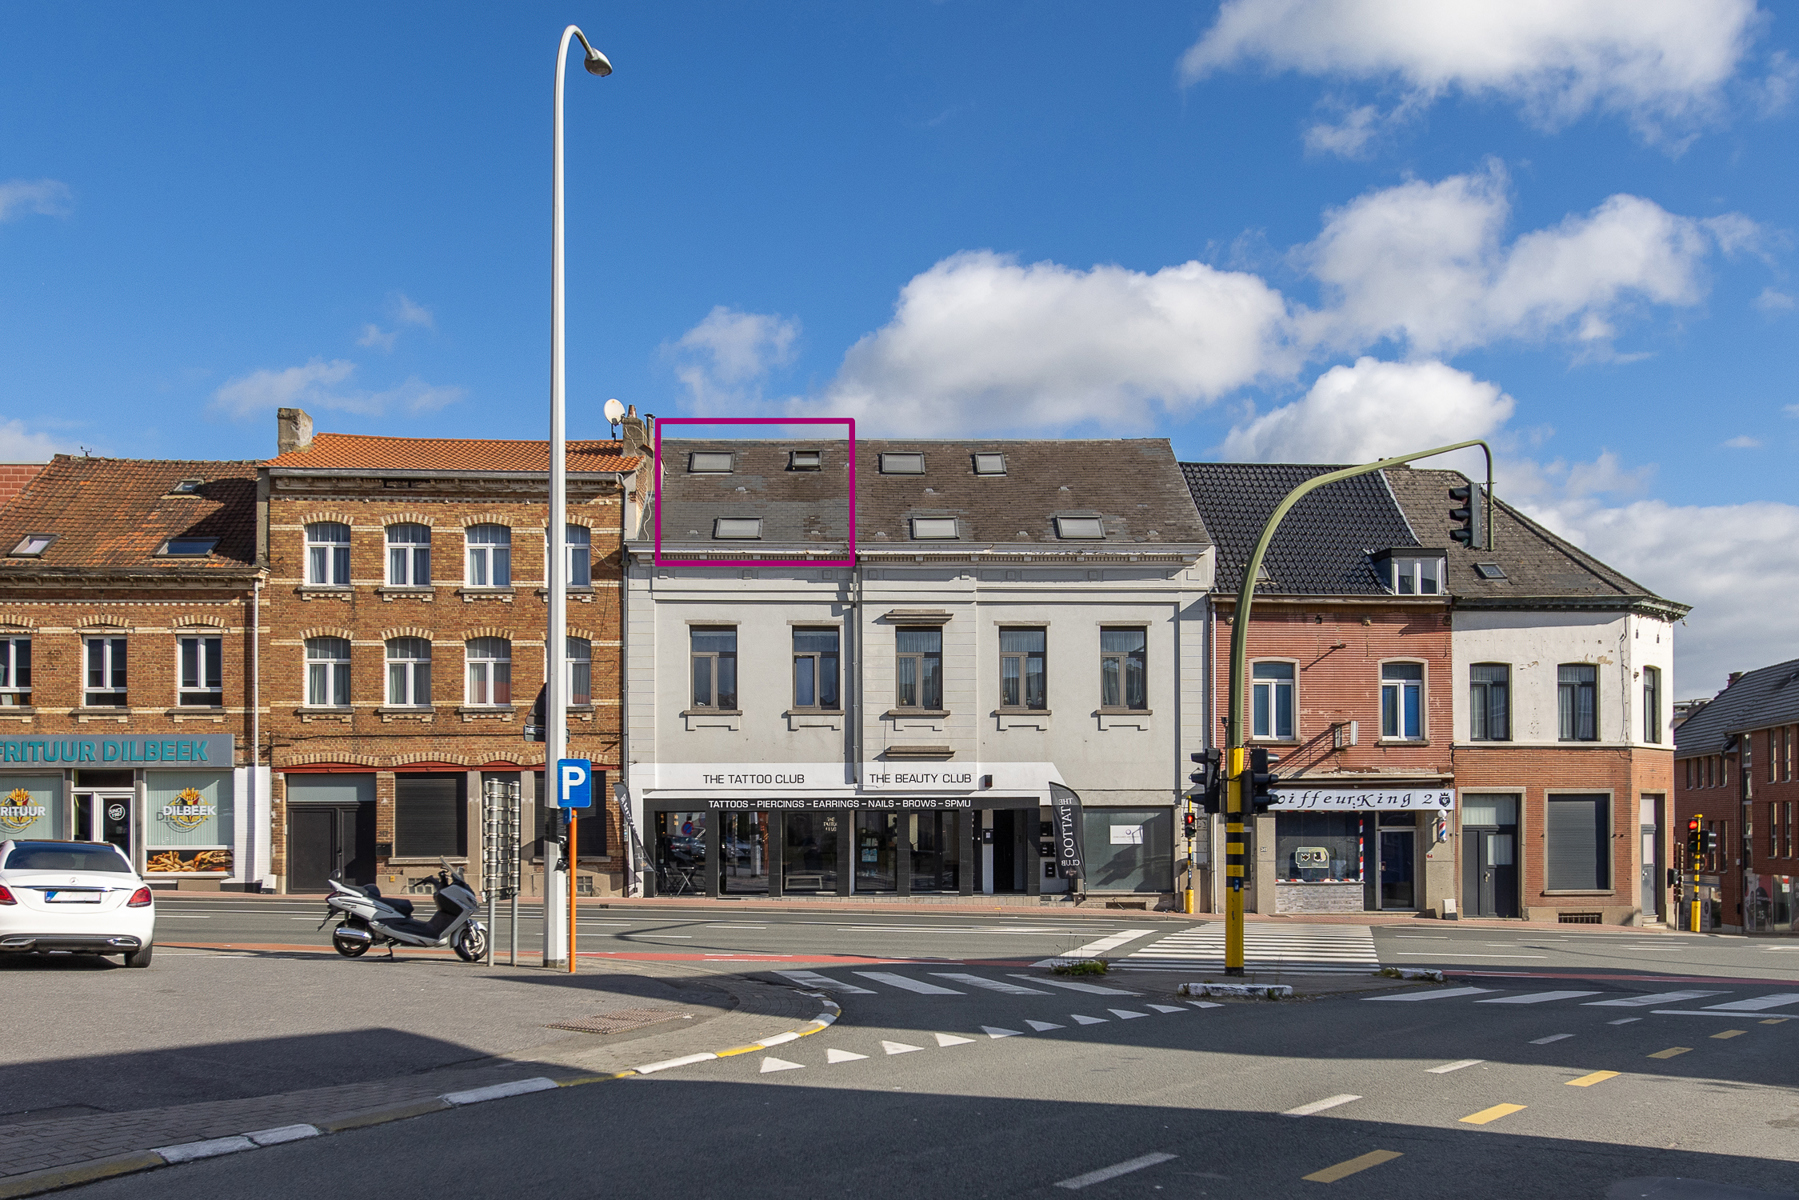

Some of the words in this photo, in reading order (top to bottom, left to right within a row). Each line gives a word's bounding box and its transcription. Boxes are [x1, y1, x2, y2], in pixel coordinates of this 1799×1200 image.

[0, 741, 96, 762] RITUUR
[103, 741, 209, 761] DILBEEK
[562, 766, 586, 800] P
[703, 774, 724, 784] THE
[728, 774, 772, 784] TATTOO
[775, 774, 805, 784] CLUB
[869, 773, 891, 783] THE
[895, 773, 938, 783] BEAUTY
[942, 773, 972, 783] CLUB
[708, 800, 749, 808] TATTOOS
[756, 800, 805, 808] PIERCINGS
[813, 800, 860, 808] EARRINGS
[867, 799, 895, 808] NAILS
[902, 799, 937, 808] BROWS
[944, 799, 971, 808] SPMU
[1422, 793, 1433, 805] 2
[0, 806, 46, 816] RITUUR
[163, 805, 216, 816] DILBEEK
